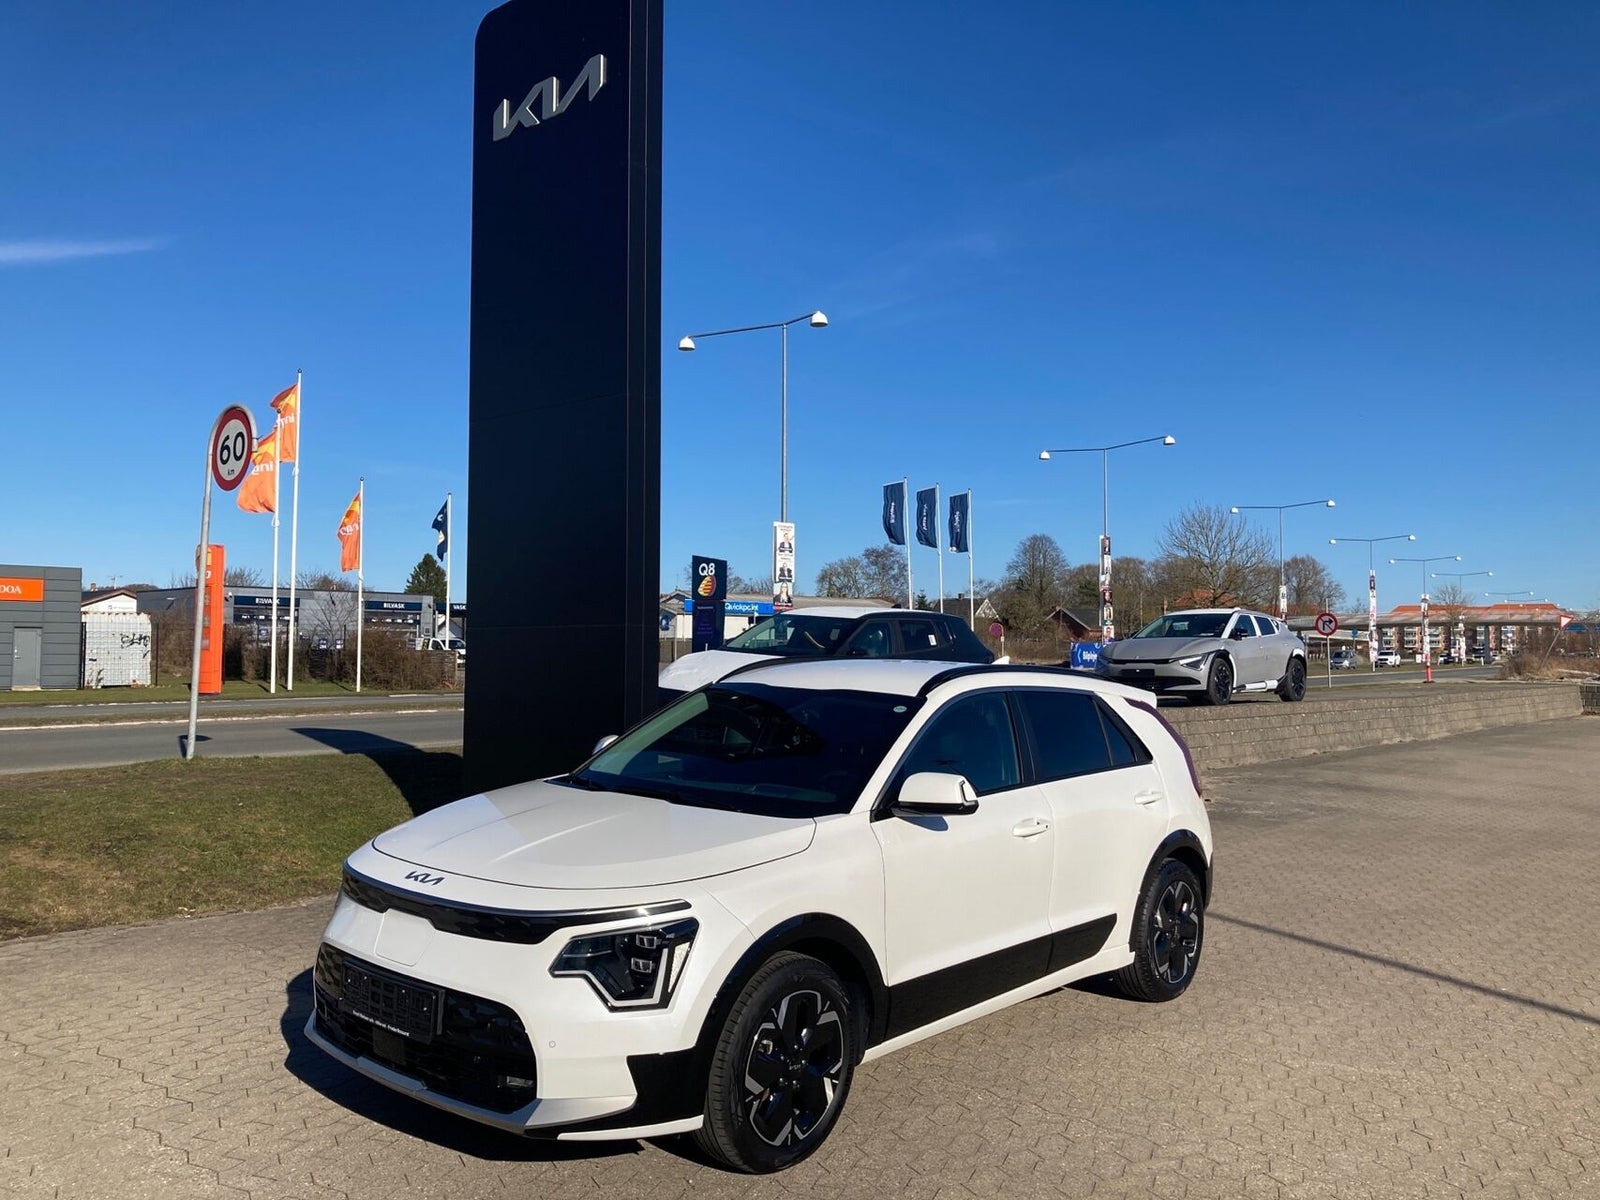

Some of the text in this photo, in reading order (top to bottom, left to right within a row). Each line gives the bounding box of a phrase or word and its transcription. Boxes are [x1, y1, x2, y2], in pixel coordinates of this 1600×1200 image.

[492, 53, 607, 142] KIA
[219, 431, 245, 466] 60
[227, 468, 235, 476] km
[698, 562, 716, 576] Q8
[383, 602, 406, 610] BILVASK
[404, 870, 446, 887] KIA
